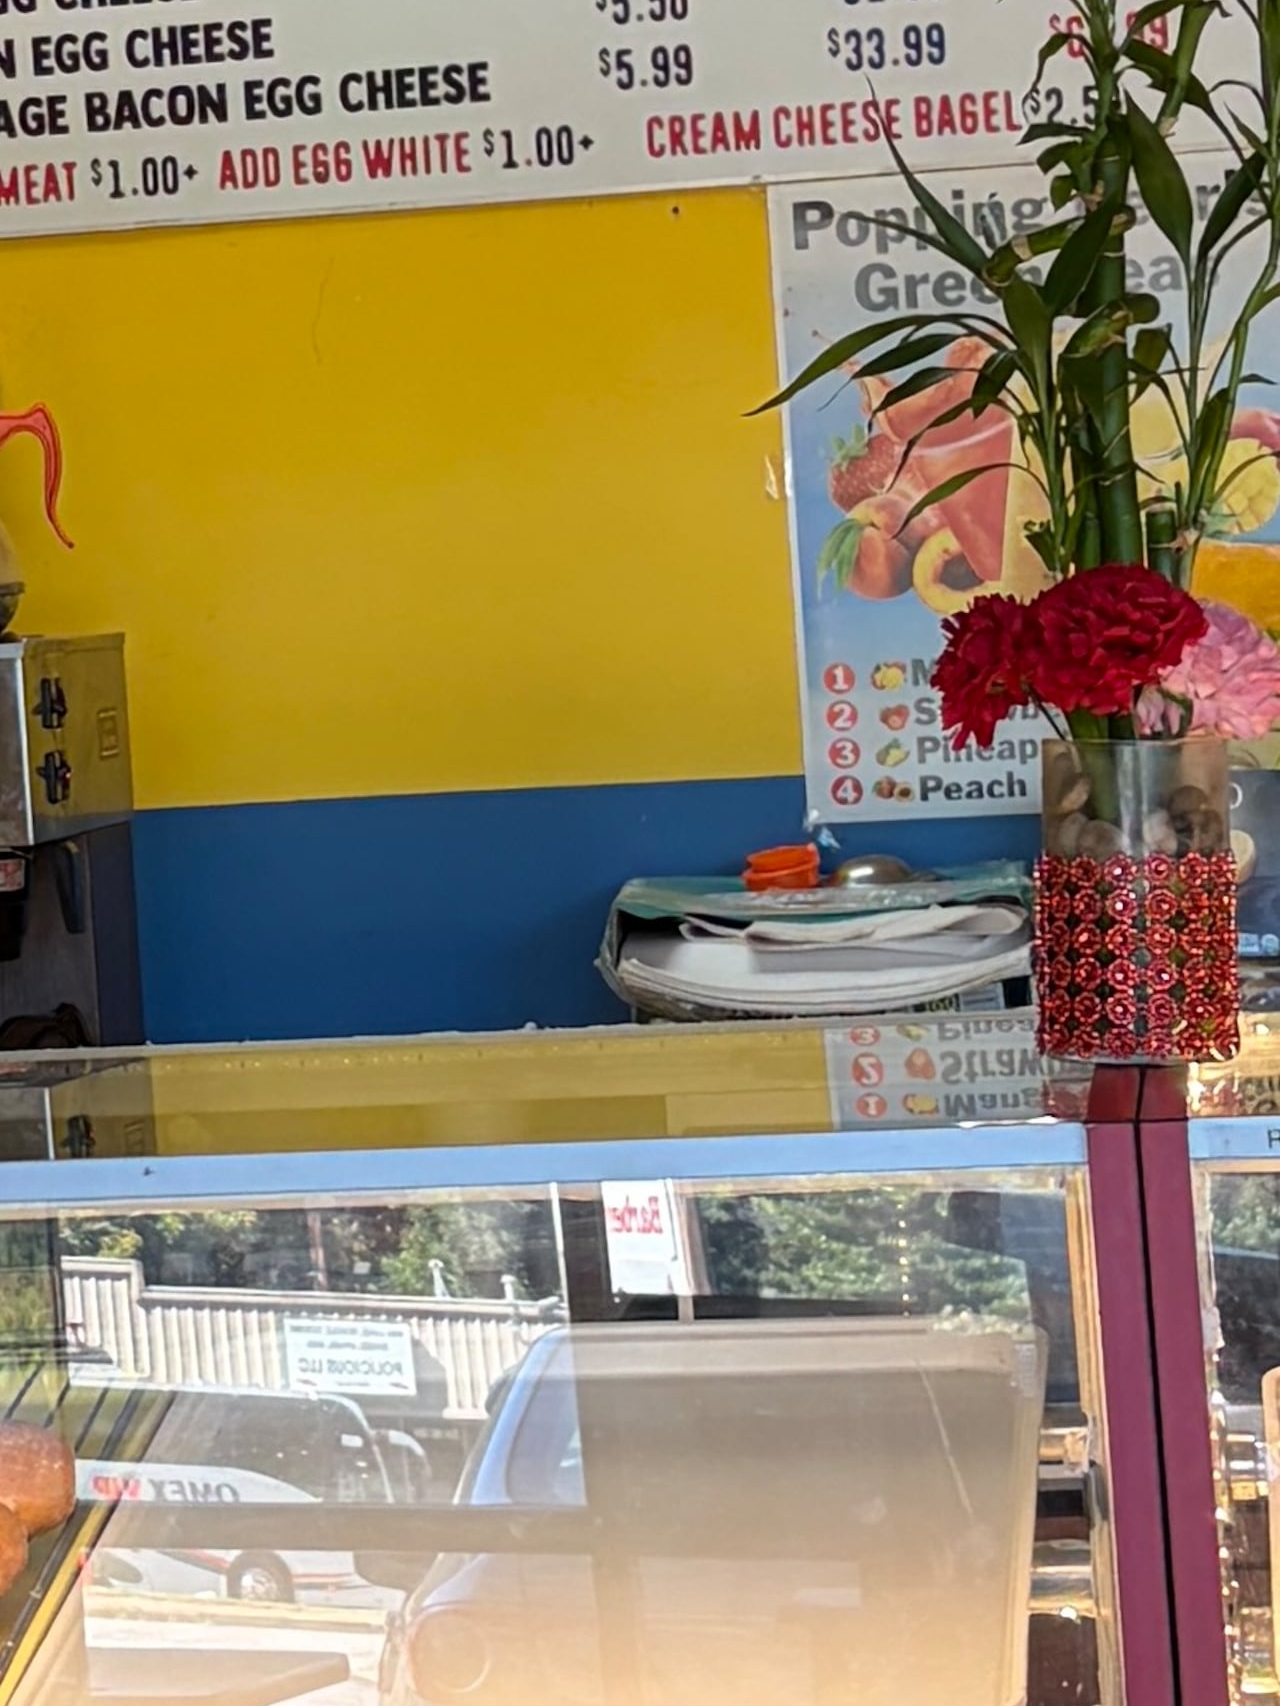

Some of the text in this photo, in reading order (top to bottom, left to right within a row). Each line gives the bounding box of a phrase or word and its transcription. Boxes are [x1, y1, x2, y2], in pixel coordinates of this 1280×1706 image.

[32, 32, 109, 76] EGG
[126, 18, 274, 68] CHEESE
[599, 23, 945, 90] $5.99 $33.99
[85, 83, 228, 132] BACON
[244, 75, 322, 120] EGG
[340, 62, 491, 112] CHEESE
[647, 91, 1022, 158] CREAM CHEESE BAGEL
[220, 132, 471, 190] ADD EGG WHITE
[920, 772, 1027, 802] Peach
